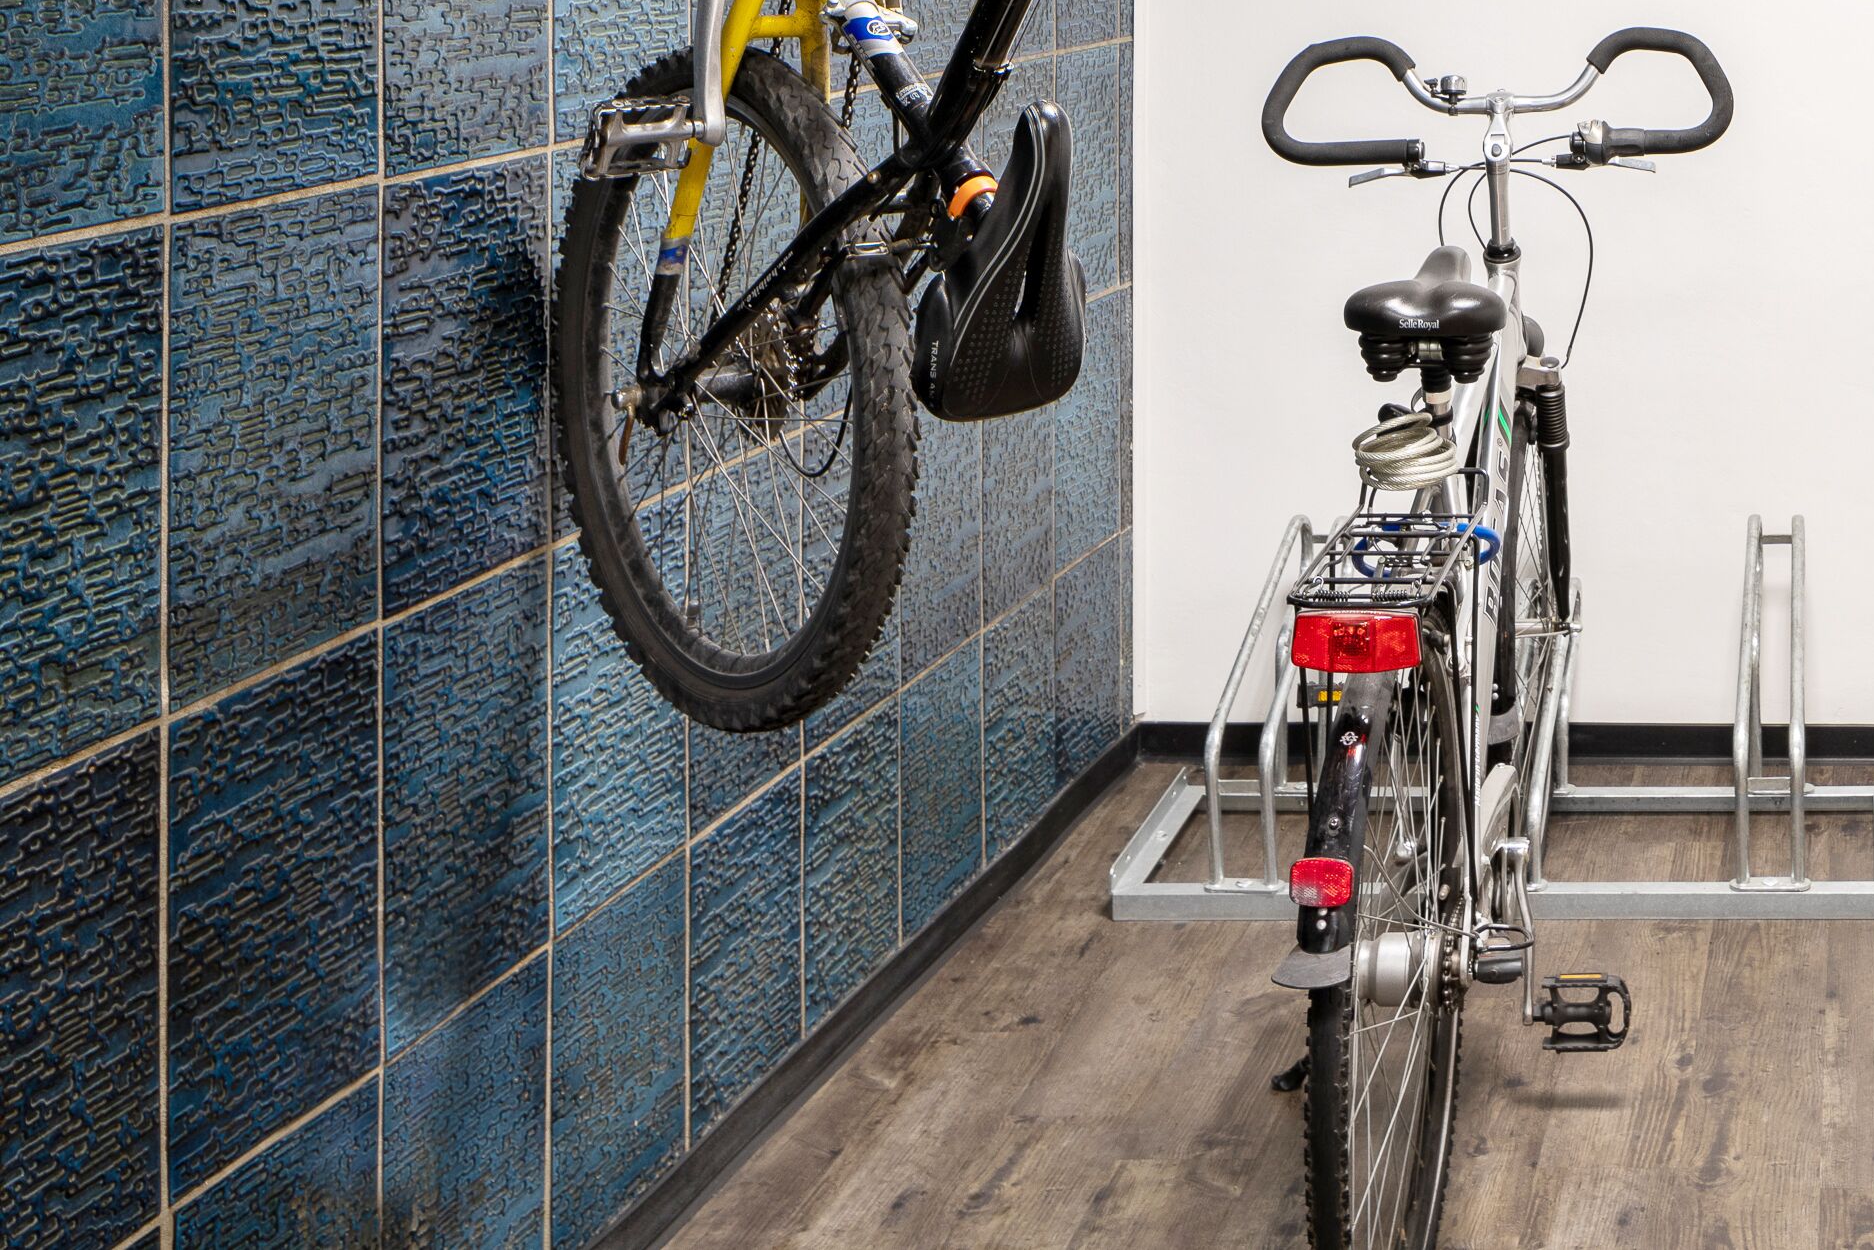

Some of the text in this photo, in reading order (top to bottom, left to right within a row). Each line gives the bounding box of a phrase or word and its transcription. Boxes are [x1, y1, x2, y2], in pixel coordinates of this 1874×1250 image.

[1399, 318, 1440, 331] Selle Royal
[929, 340, 939, 379] TRANS
